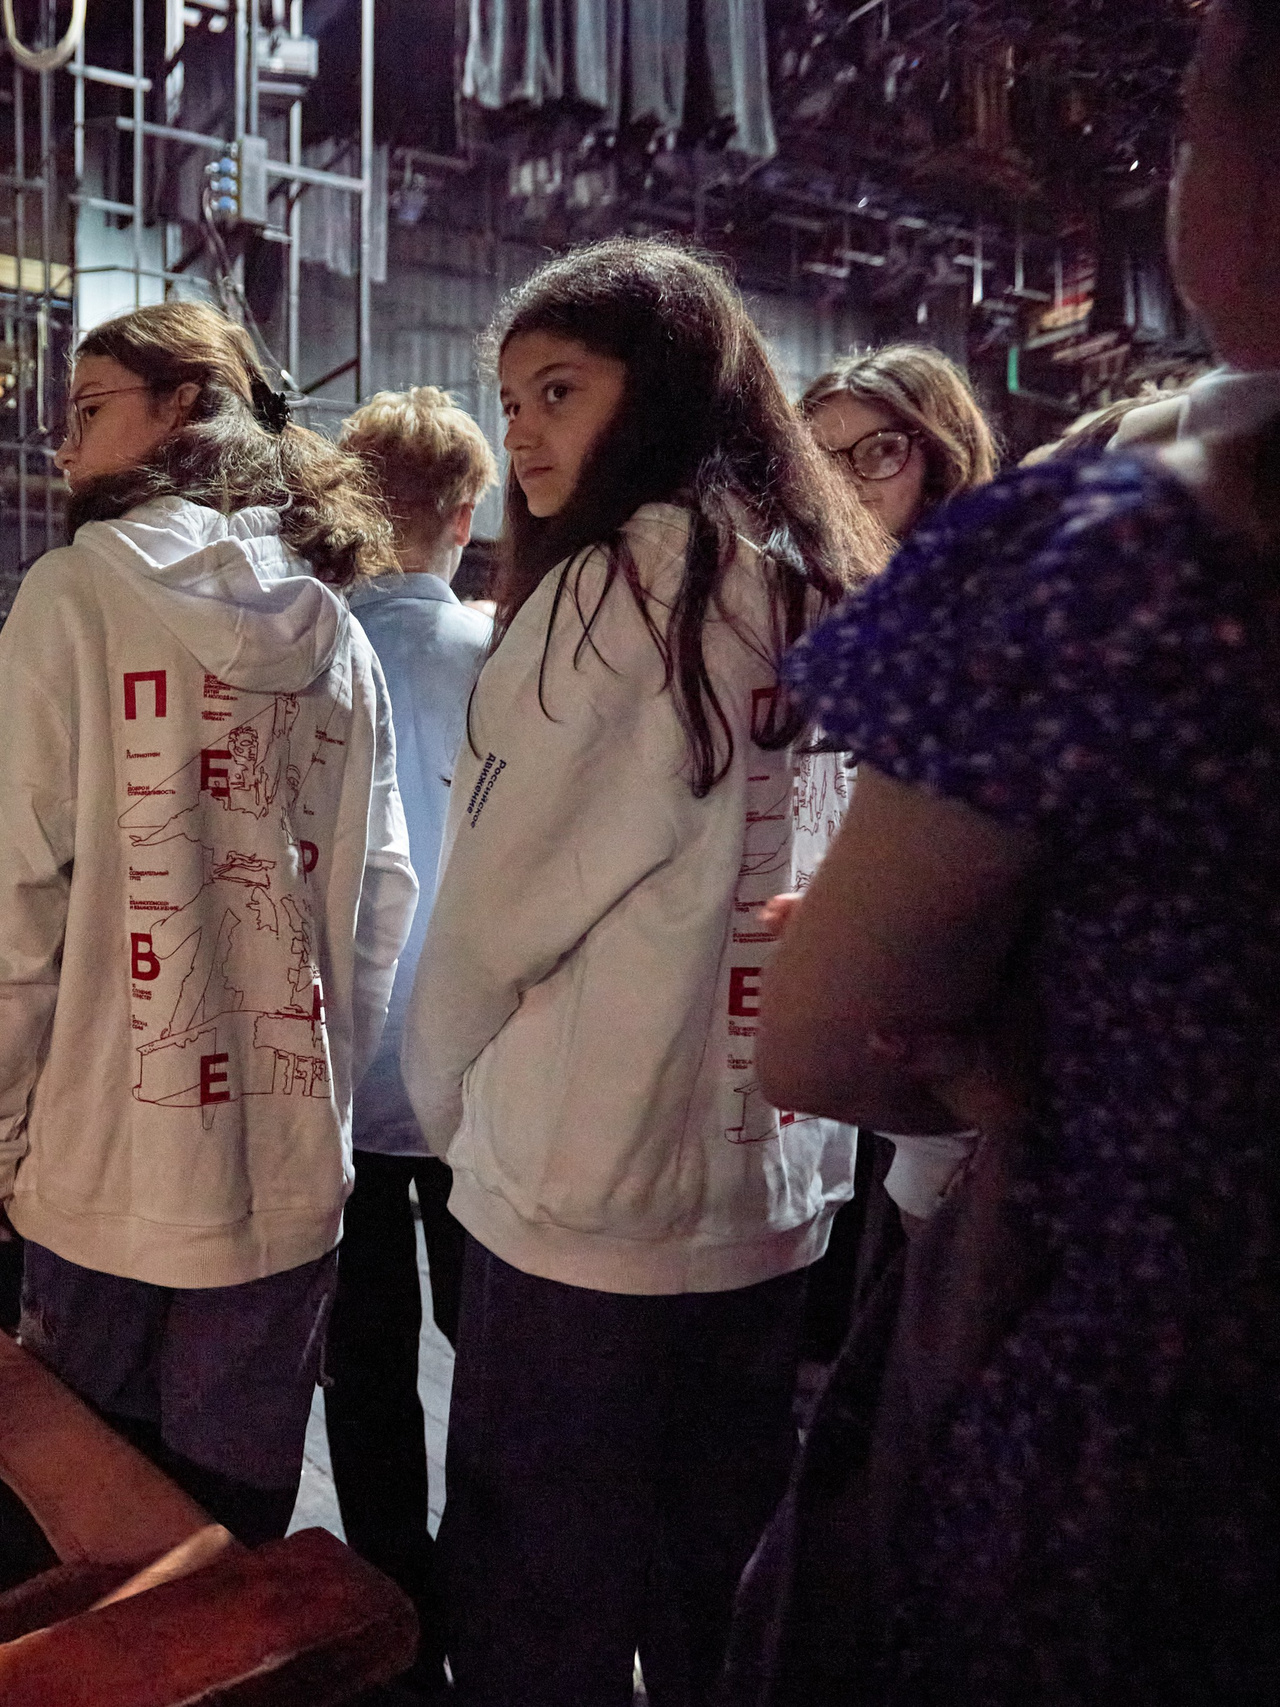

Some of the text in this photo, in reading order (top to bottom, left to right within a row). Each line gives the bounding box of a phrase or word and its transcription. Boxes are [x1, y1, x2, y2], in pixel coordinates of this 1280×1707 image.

[123, 670, 166, 720] П
[201, 749, 233, 797] Е
[467, 752, 497, 814] Движение
[470, 759, 507, 829] Российское
[130, 932, 161, 981] В
[201, 1053, 230, 1104] Е
